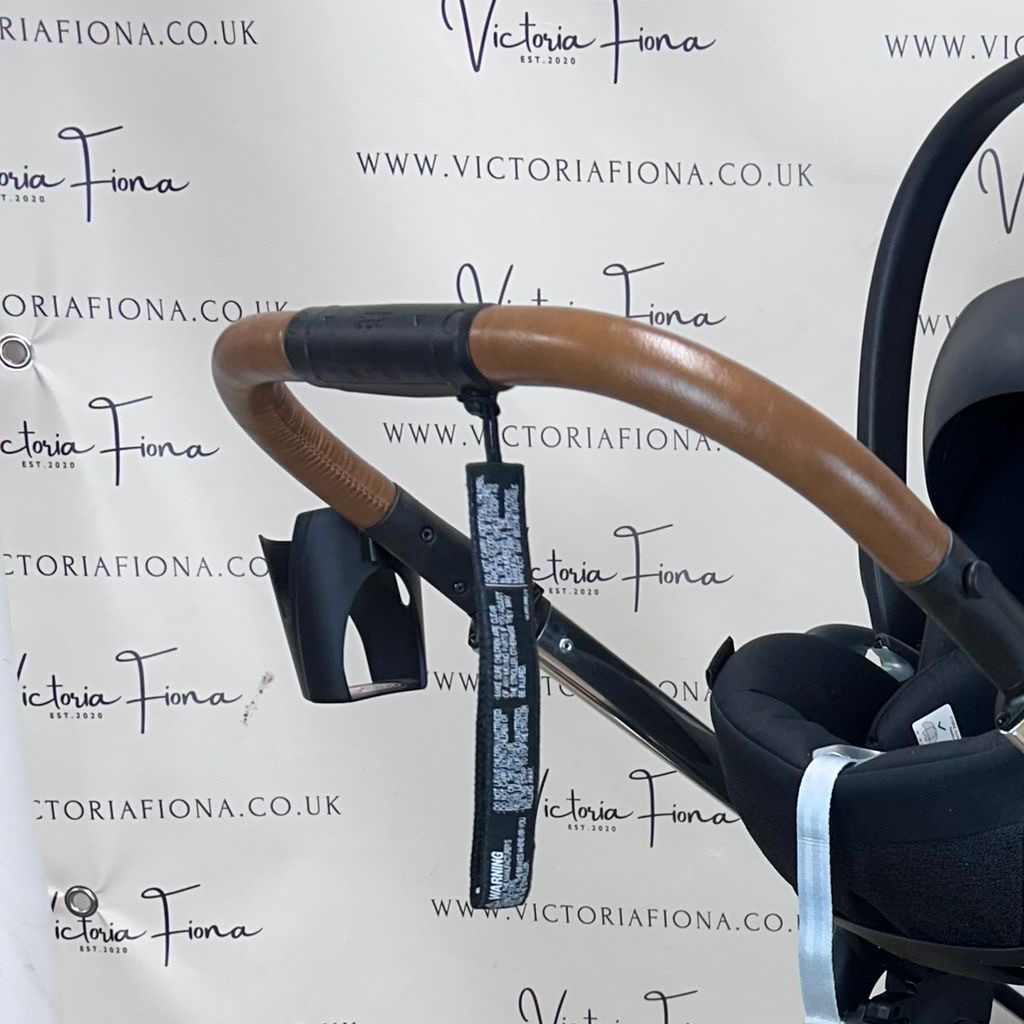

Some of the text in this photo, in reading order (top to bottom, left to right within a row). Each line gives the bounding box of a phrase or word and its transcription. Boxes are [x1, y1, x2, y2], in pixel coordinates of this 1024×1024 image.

[441, 0, 596, 73] Victoria
[520, 55, 575, 65] EST.2020
[58, 126, 190, 222] Fiona
[356, 152, 814, 187] WWW.VICTORIAFIONA.CO.UK
[22, 461, 75, 469] EST.2020
[89, 396, 219, 486] Fiona
[549, 587, 599, 595] EST.2020
[613, 524, 733, 613] Fiona
[116, 647, 243, 734] Fiona
[568, 824, 616, 832] EST.2020
[629, 769, 741, 848] Fiona
[488, 851, 503, 900] WARNING
[80, 945, 127, 954] EST.2020
[141, 884, 263, 967] Fiona
